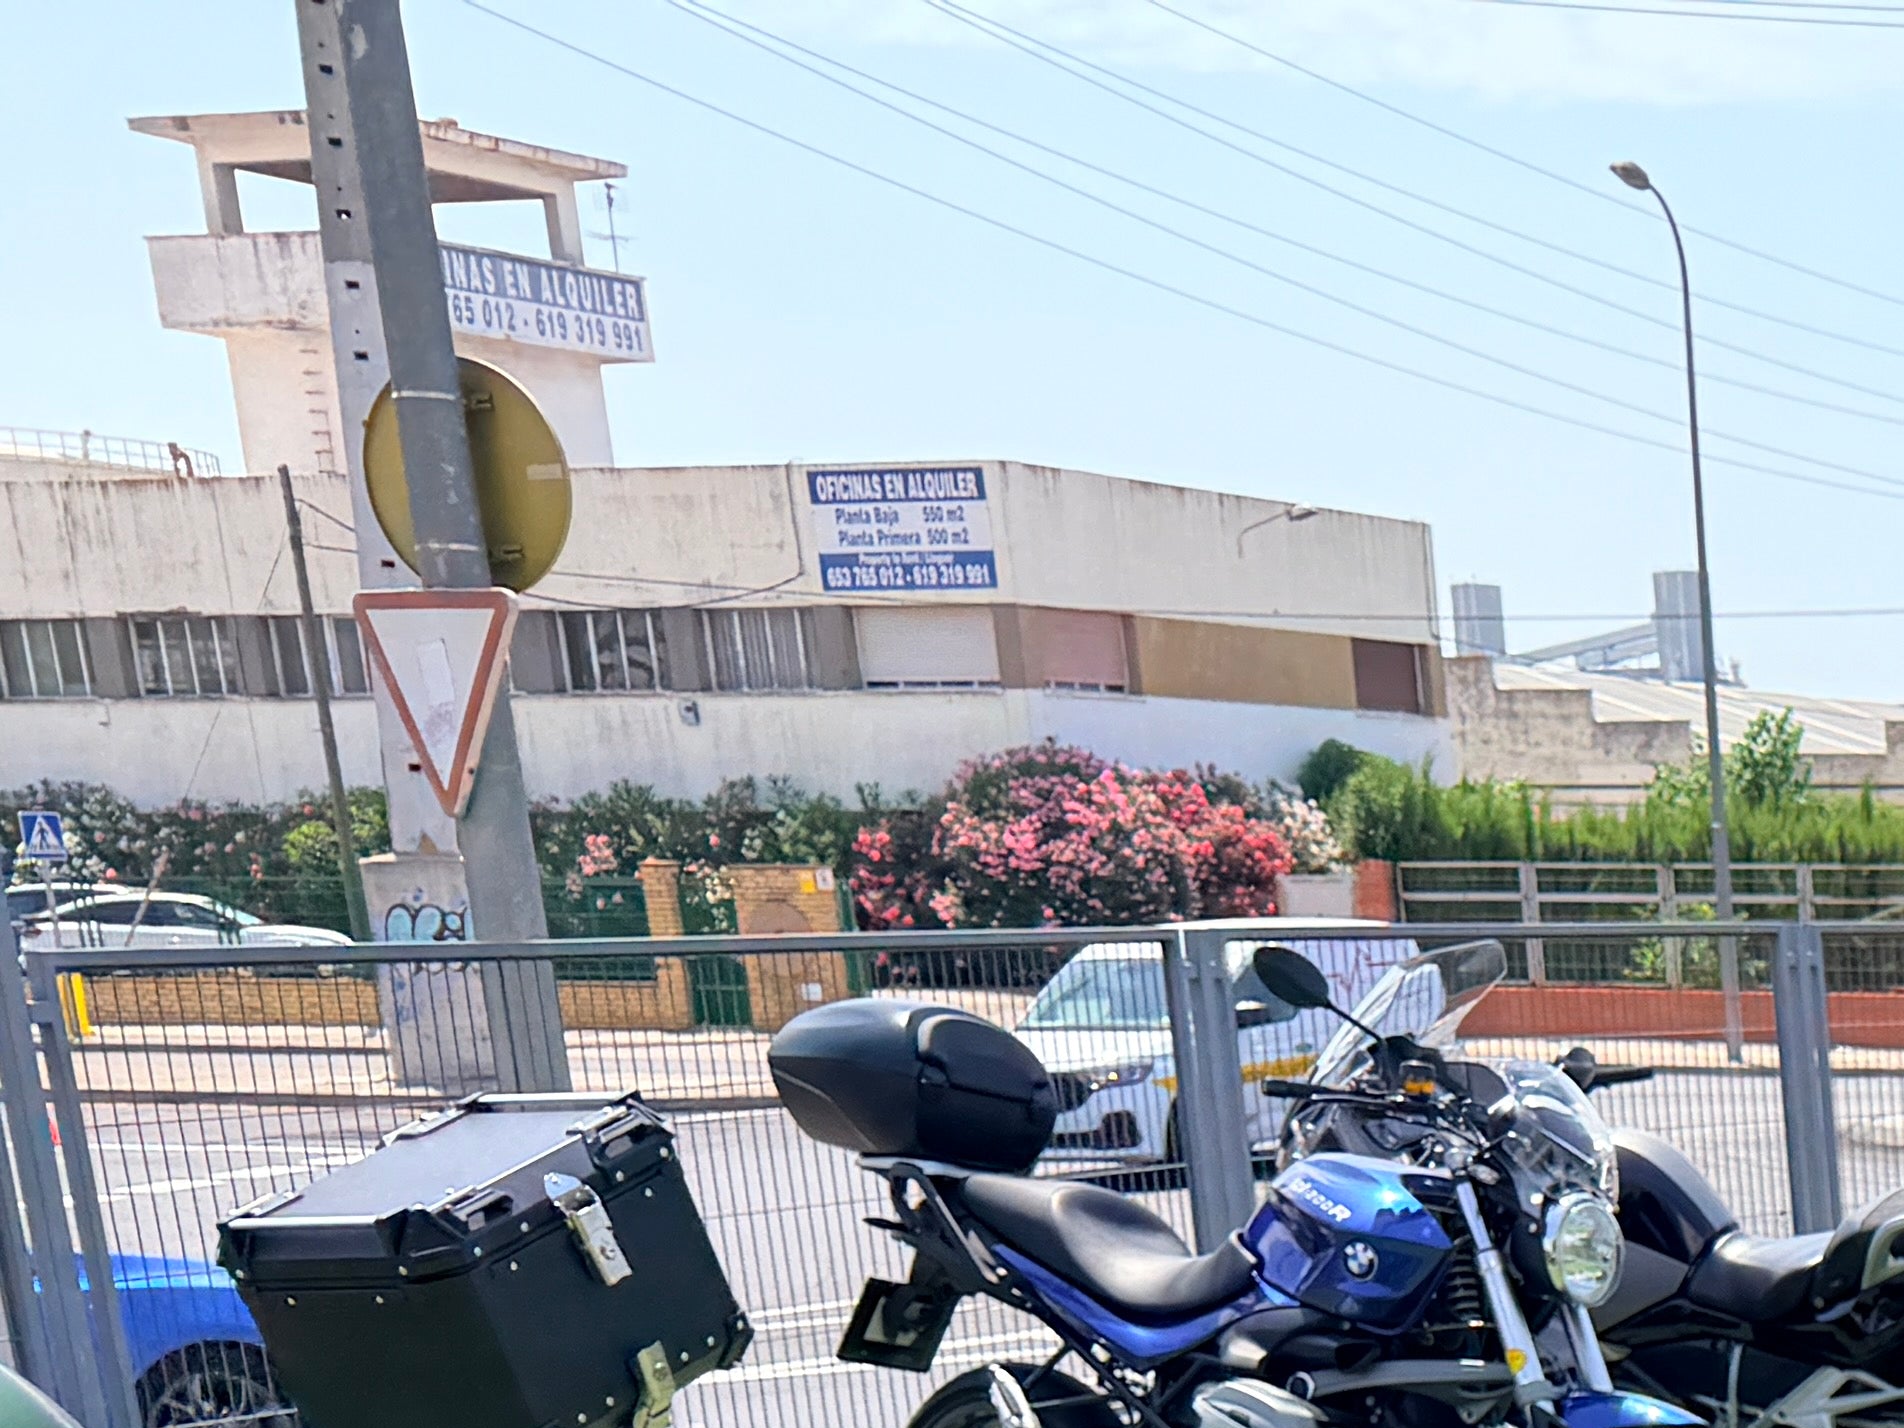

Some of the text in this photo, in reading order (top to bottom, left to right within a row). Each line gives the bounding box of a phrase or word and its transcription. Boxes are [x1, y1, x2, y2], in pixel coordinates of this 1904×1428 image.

[441, 248, 641, 319] INAS EN ALQUILER
[452, 293, 644, 352] 65 012 619 319 991
[815, 471, 980, 501] OFICINAS EN ALQUILER
[835, 507, 872, 525] Planta
[873, 505, 900, 527] Baja
[946, 505, 966, 522] m2
[838, 529, 874, 547] Planta
[876, 528, 922, 547] Primera
[951, 527, 971, 545] m2
